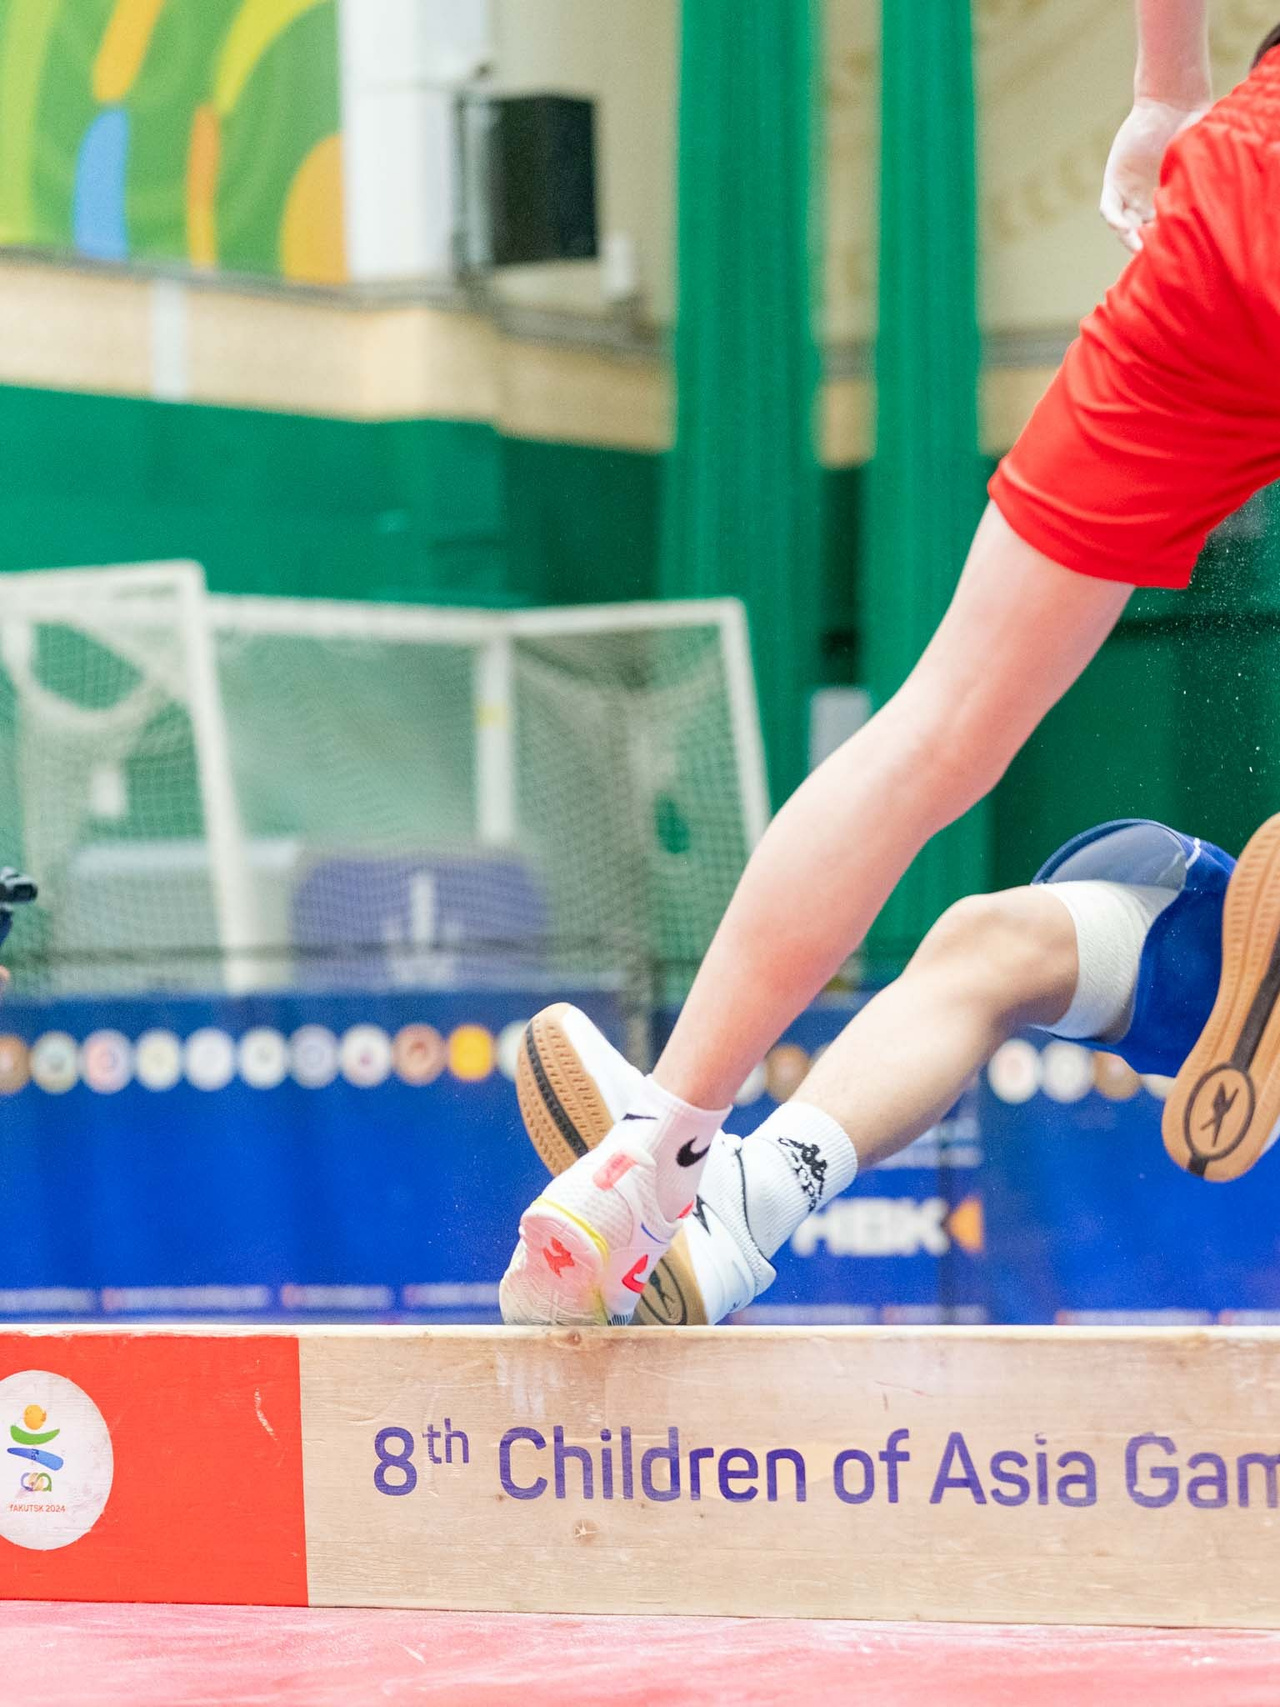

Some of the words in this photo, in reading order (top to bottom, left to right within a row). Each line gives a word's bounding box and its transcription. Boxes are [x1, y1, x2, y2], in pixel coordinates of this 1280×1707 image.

[373, 1417, 470, 1497] 8th
[499, 1425, 807, 1502] Children
[832, 1427, 911, 1504] of
[928, 1431, 1097, 1507] Asia
[45, 1503, 66, 1513] 2024
